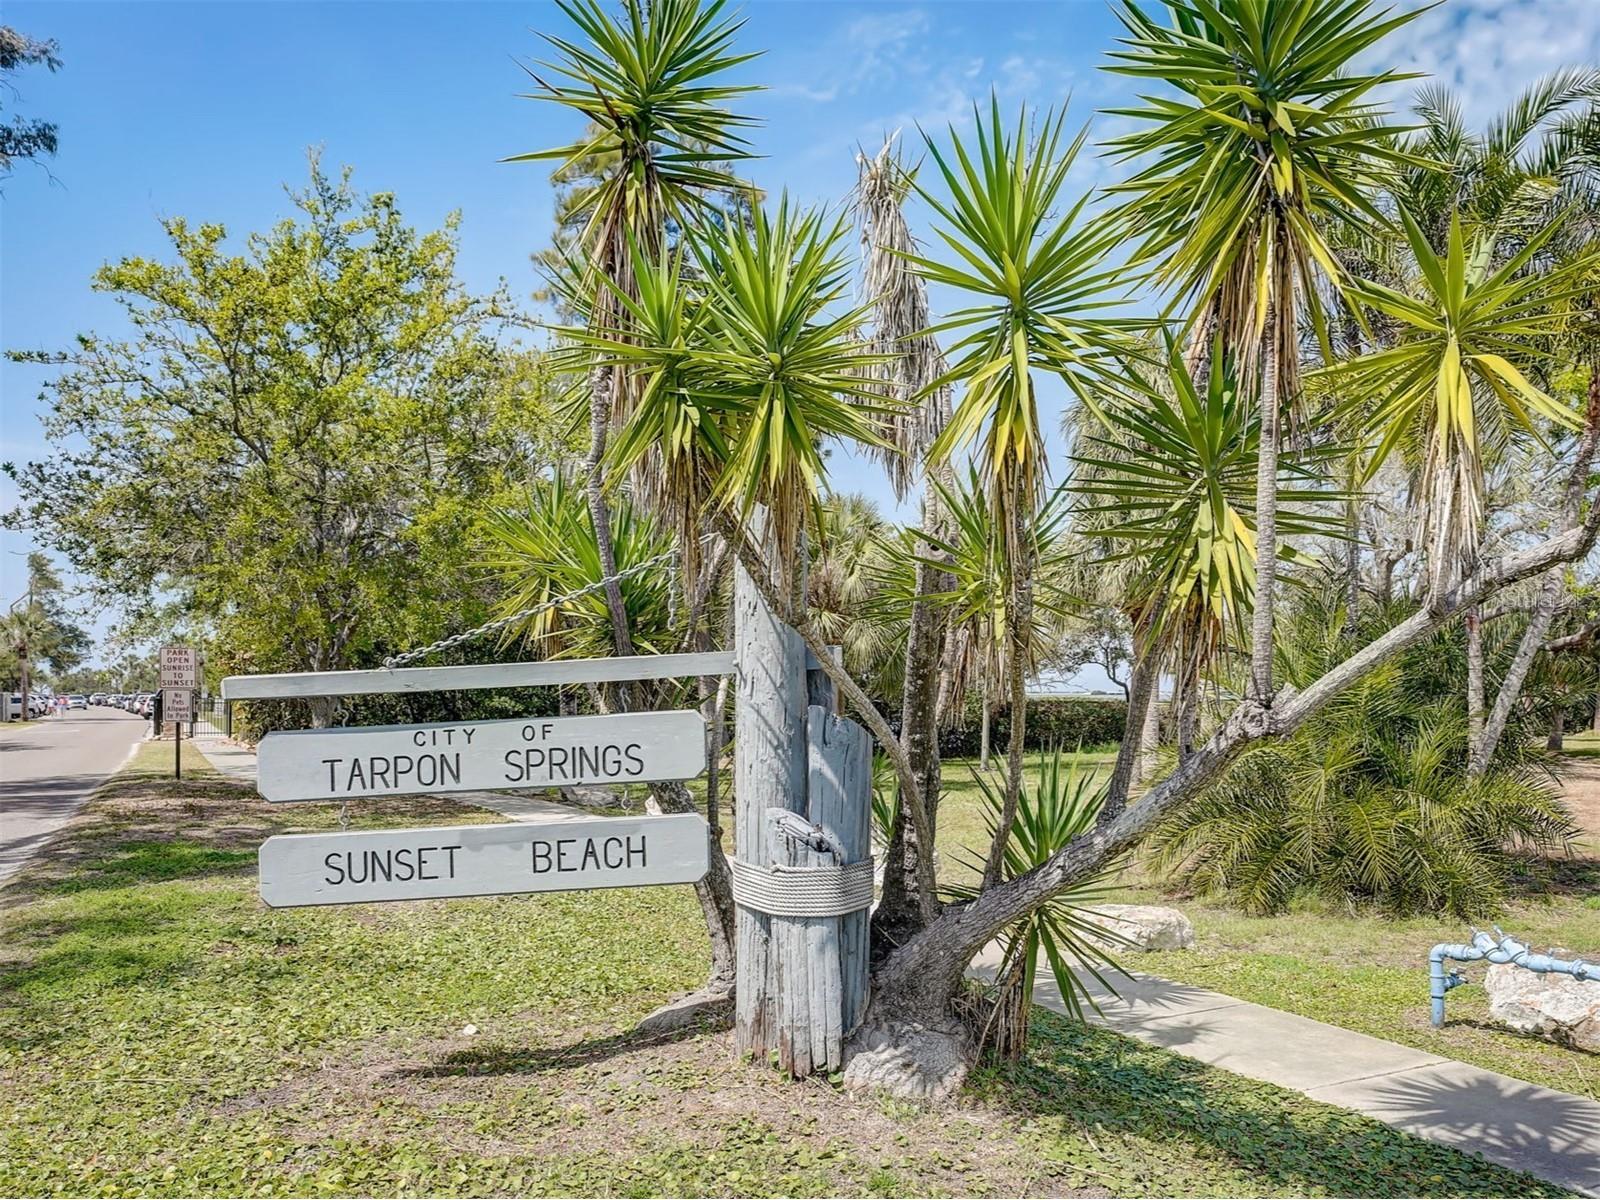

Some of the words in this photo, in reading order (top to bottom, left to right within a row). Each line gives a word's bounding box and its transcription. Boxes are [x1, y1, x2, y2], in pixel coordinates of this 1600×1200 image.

[413, 728, 476, 747] CITY
[521, 724, 554, 742] OF
[321, 752, 461, 792] TARPON
[504, 743, 645, 783] SPRINGS
[324, 845, 463, 885] SUNSET
[531, 835, 647, 874] BEACH
